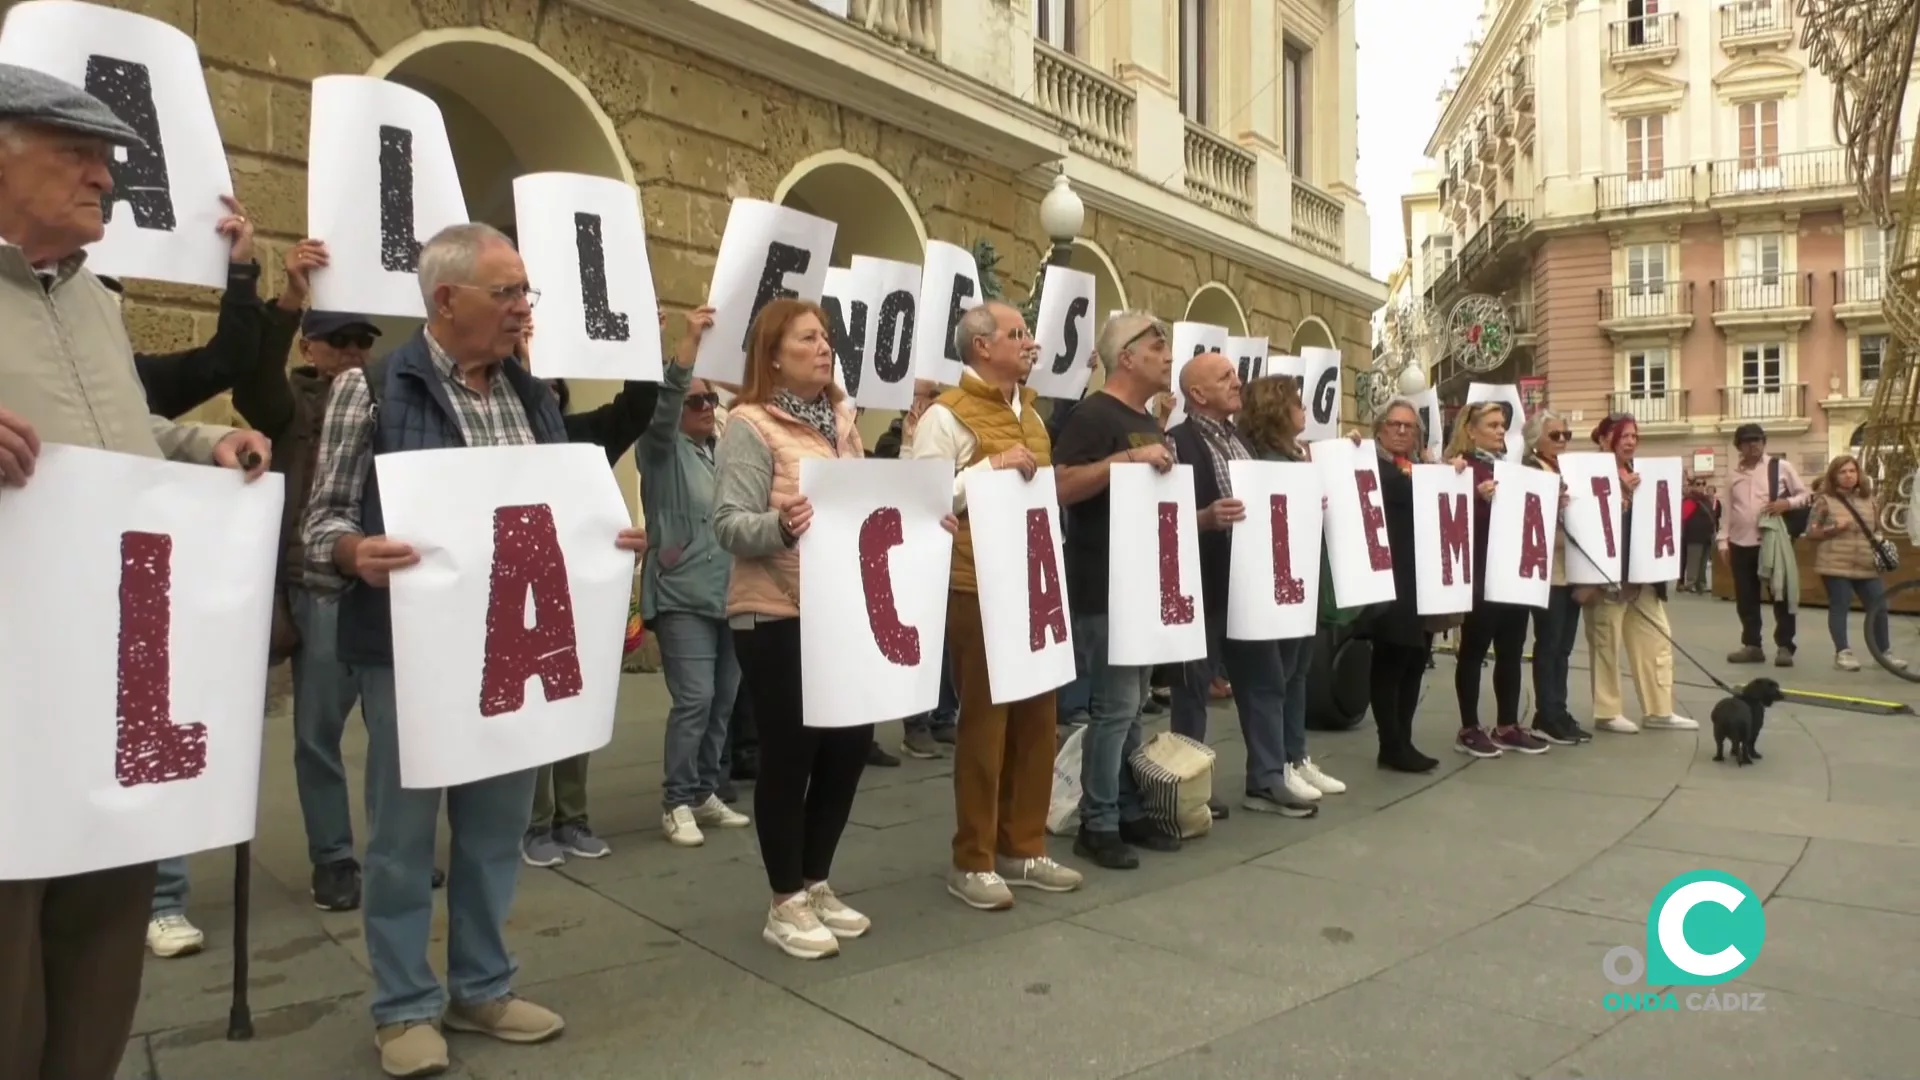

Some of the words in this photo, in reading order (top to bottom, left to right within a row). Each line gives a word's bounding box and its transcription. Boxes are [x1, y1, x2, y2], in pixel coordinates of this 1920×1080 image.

[379, 125, 424, 273] L
[574, 211, 630, 342] L
[874, 289, 916, 383] O
[1052, 296, 1089, 375] S
[1312, 366, 1339, 425] G
[1157, 501, 1194, 626] L
[1270, 494, 1305, 606] L
[1354, 469, 1393, 572] E
[1437, 493, 1471, 586] M
[1519, 492, 1548, 581] A
[1590, 476, 1616, 558] T
[1654, 480, 1675, 559] A
[479, 503, 583, 718] A
[858, 506, 921, 667] C
[1026, 507, 1067, 652] A
[116, 530, 208, 788] L
